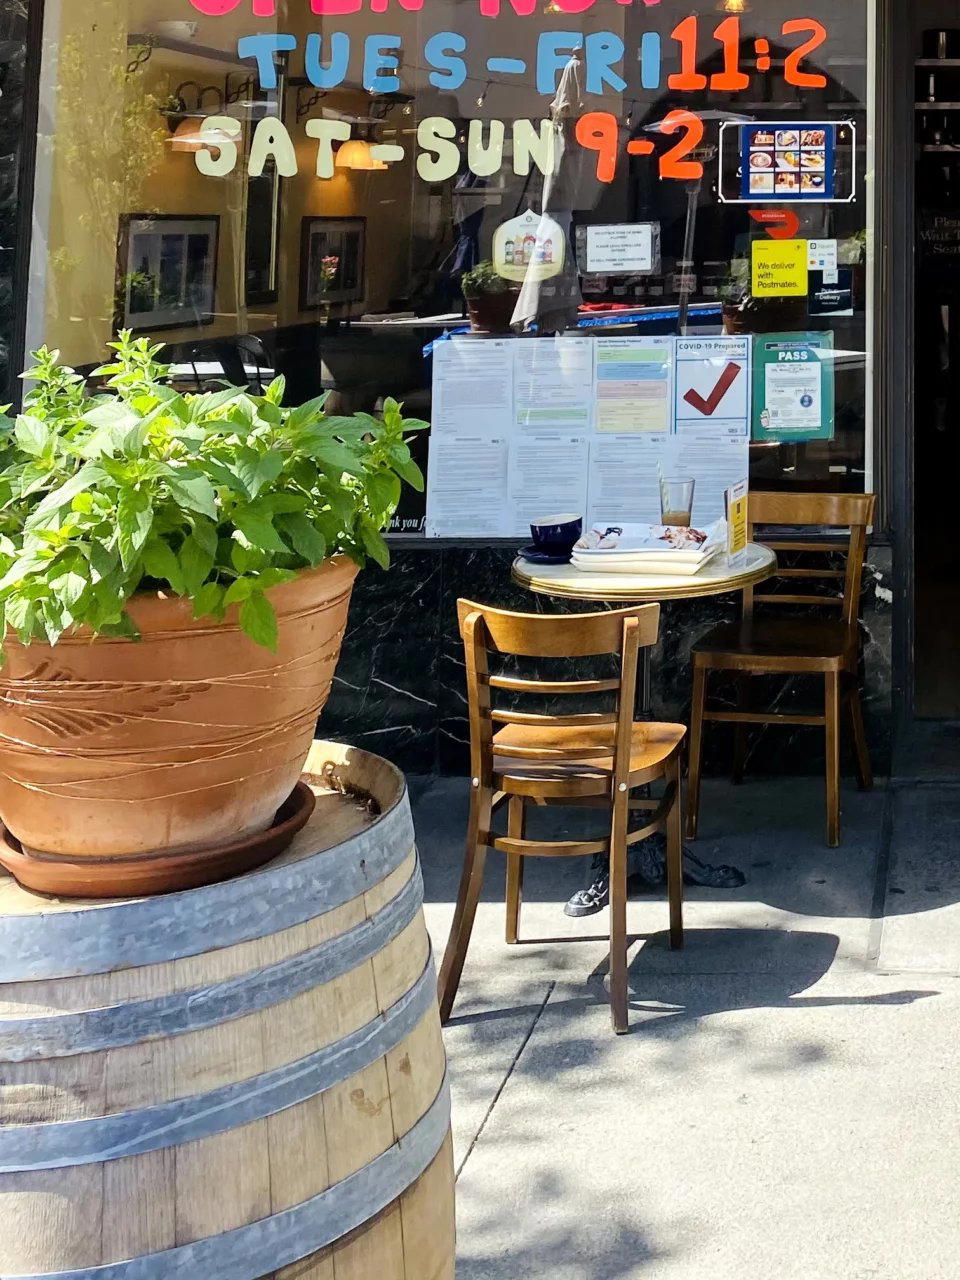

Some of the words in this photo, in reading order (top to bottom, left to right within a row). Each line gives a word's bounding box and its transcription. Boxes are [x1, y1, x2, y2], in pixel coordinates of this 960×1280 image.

[669, 15, 827, 91] 11:2
[575, 111, 704, 183] 9-2
[757, 262, 769, 270] We
[778, 351, 808, 360] PASS
[400, 518, 418, 531] you
